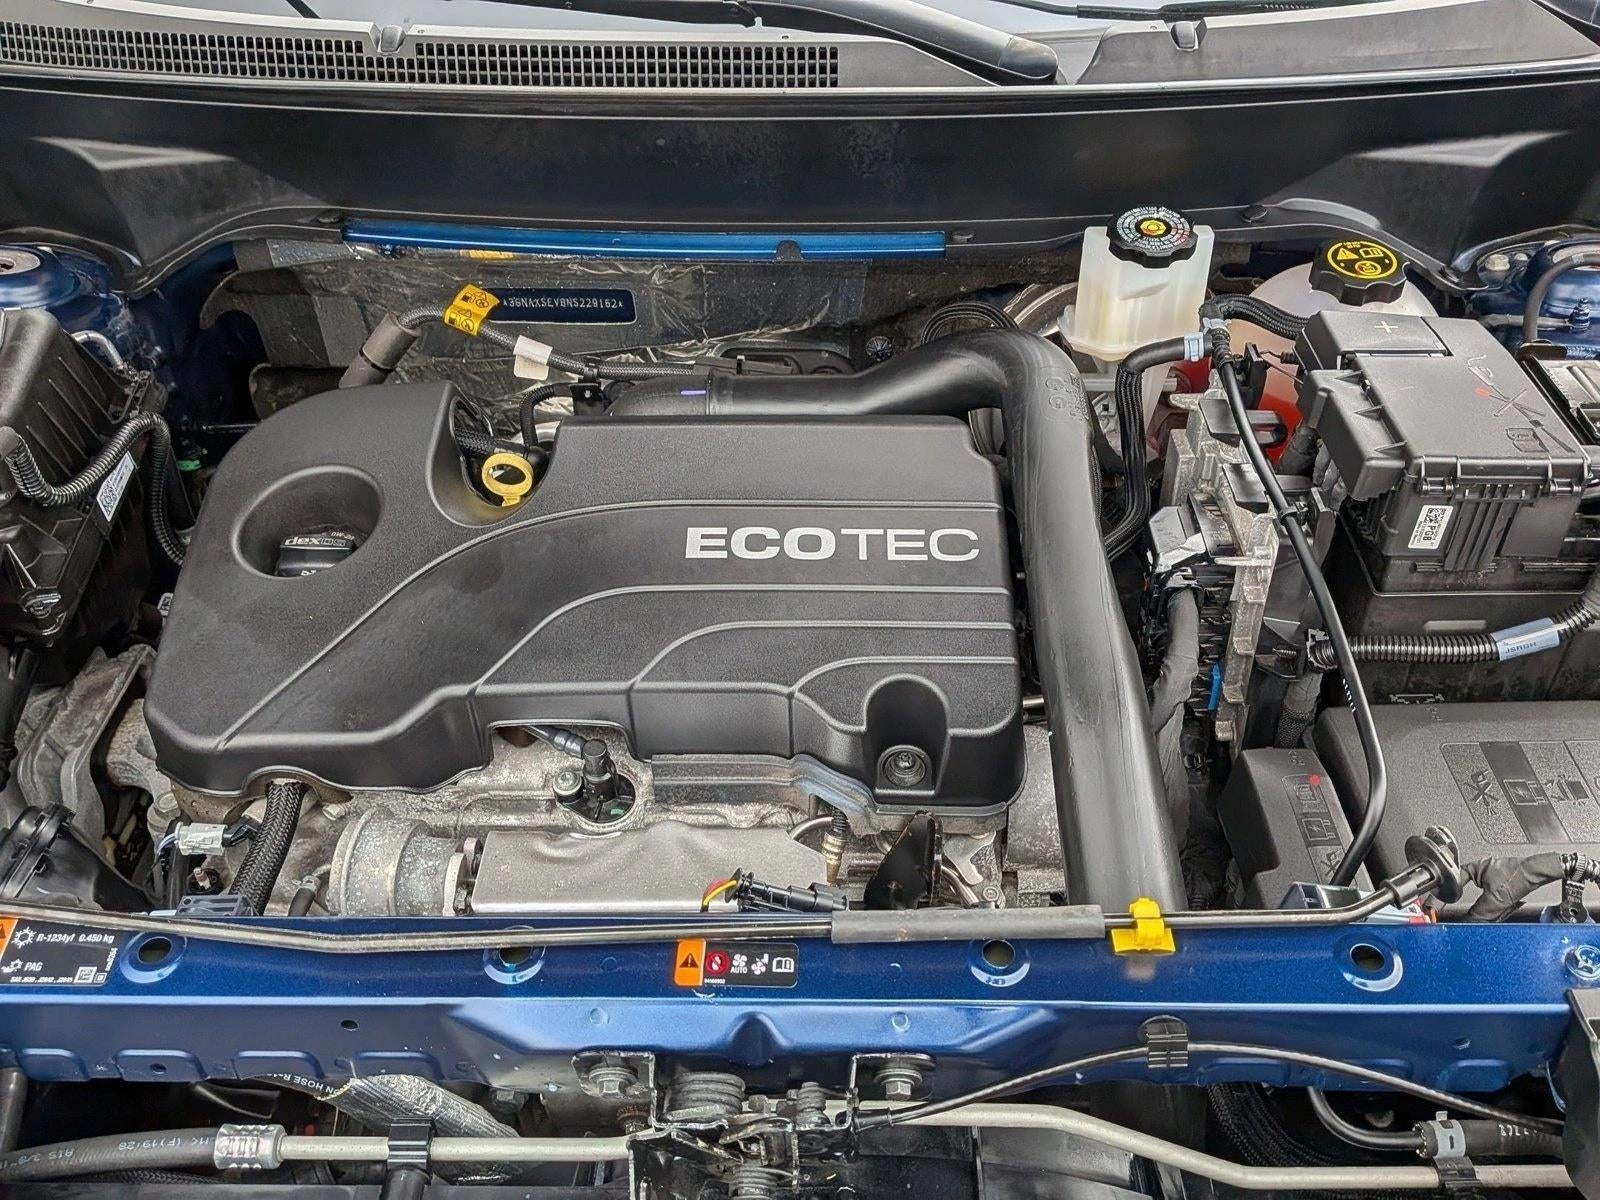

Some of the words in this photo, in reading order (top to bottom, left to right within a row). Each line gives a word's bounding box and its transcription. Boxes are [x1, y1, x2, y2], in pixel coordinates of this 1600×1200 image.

[1422, 525, 1437, 541] PGB
[285, 537, 347, 546] dexos
[684, 526, 980, 562] ECOTEC
[36, 933, 76, 944] R-1234yf
[78, 933, 103, 943] 0.450
[103, 934, 115, 944] kg
[24, 962, 43, 971] PAG
[730, 966, 748, 974] AUTO
[293, 1075, 324, 1091] HOSE
